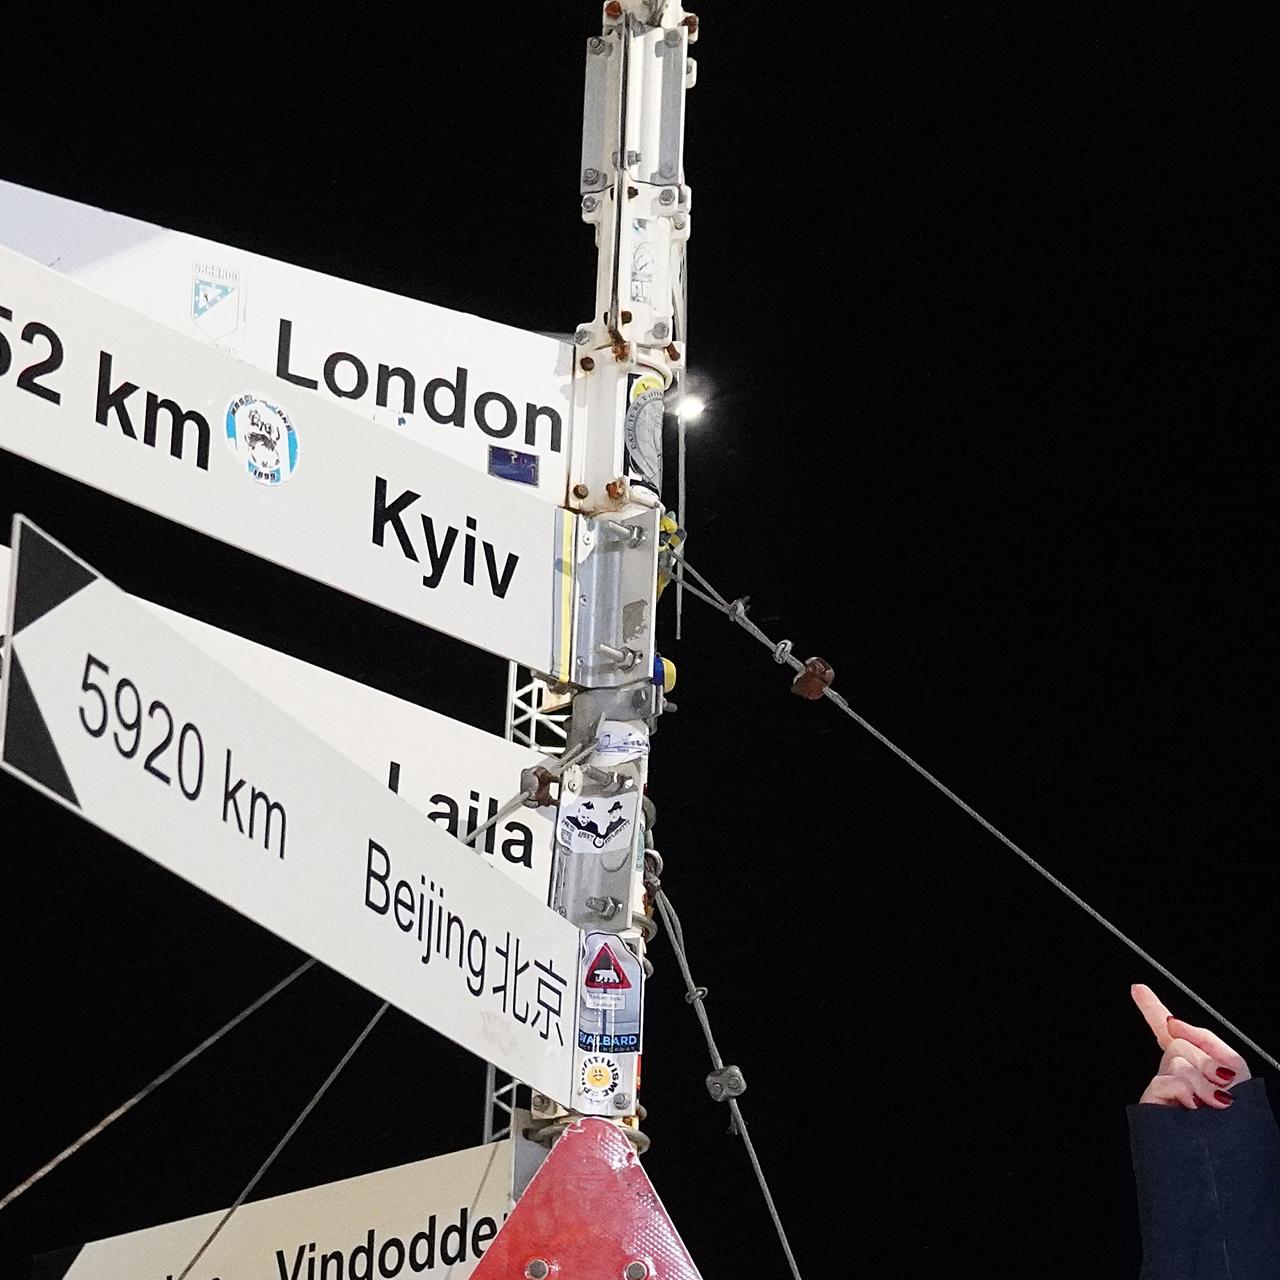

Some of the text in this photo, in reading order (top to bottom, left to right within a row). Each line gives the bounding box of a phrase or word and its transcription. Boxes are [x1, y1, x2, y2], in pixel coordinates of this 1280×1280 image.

[95, 350, 211, 471] km
[371, 475, 520, 600] Kyiv
[276, 318, 562, 453] London
[79, 653, 487, 997] 5920 km Beijing
[492, 931, 567, 1046] 北京
